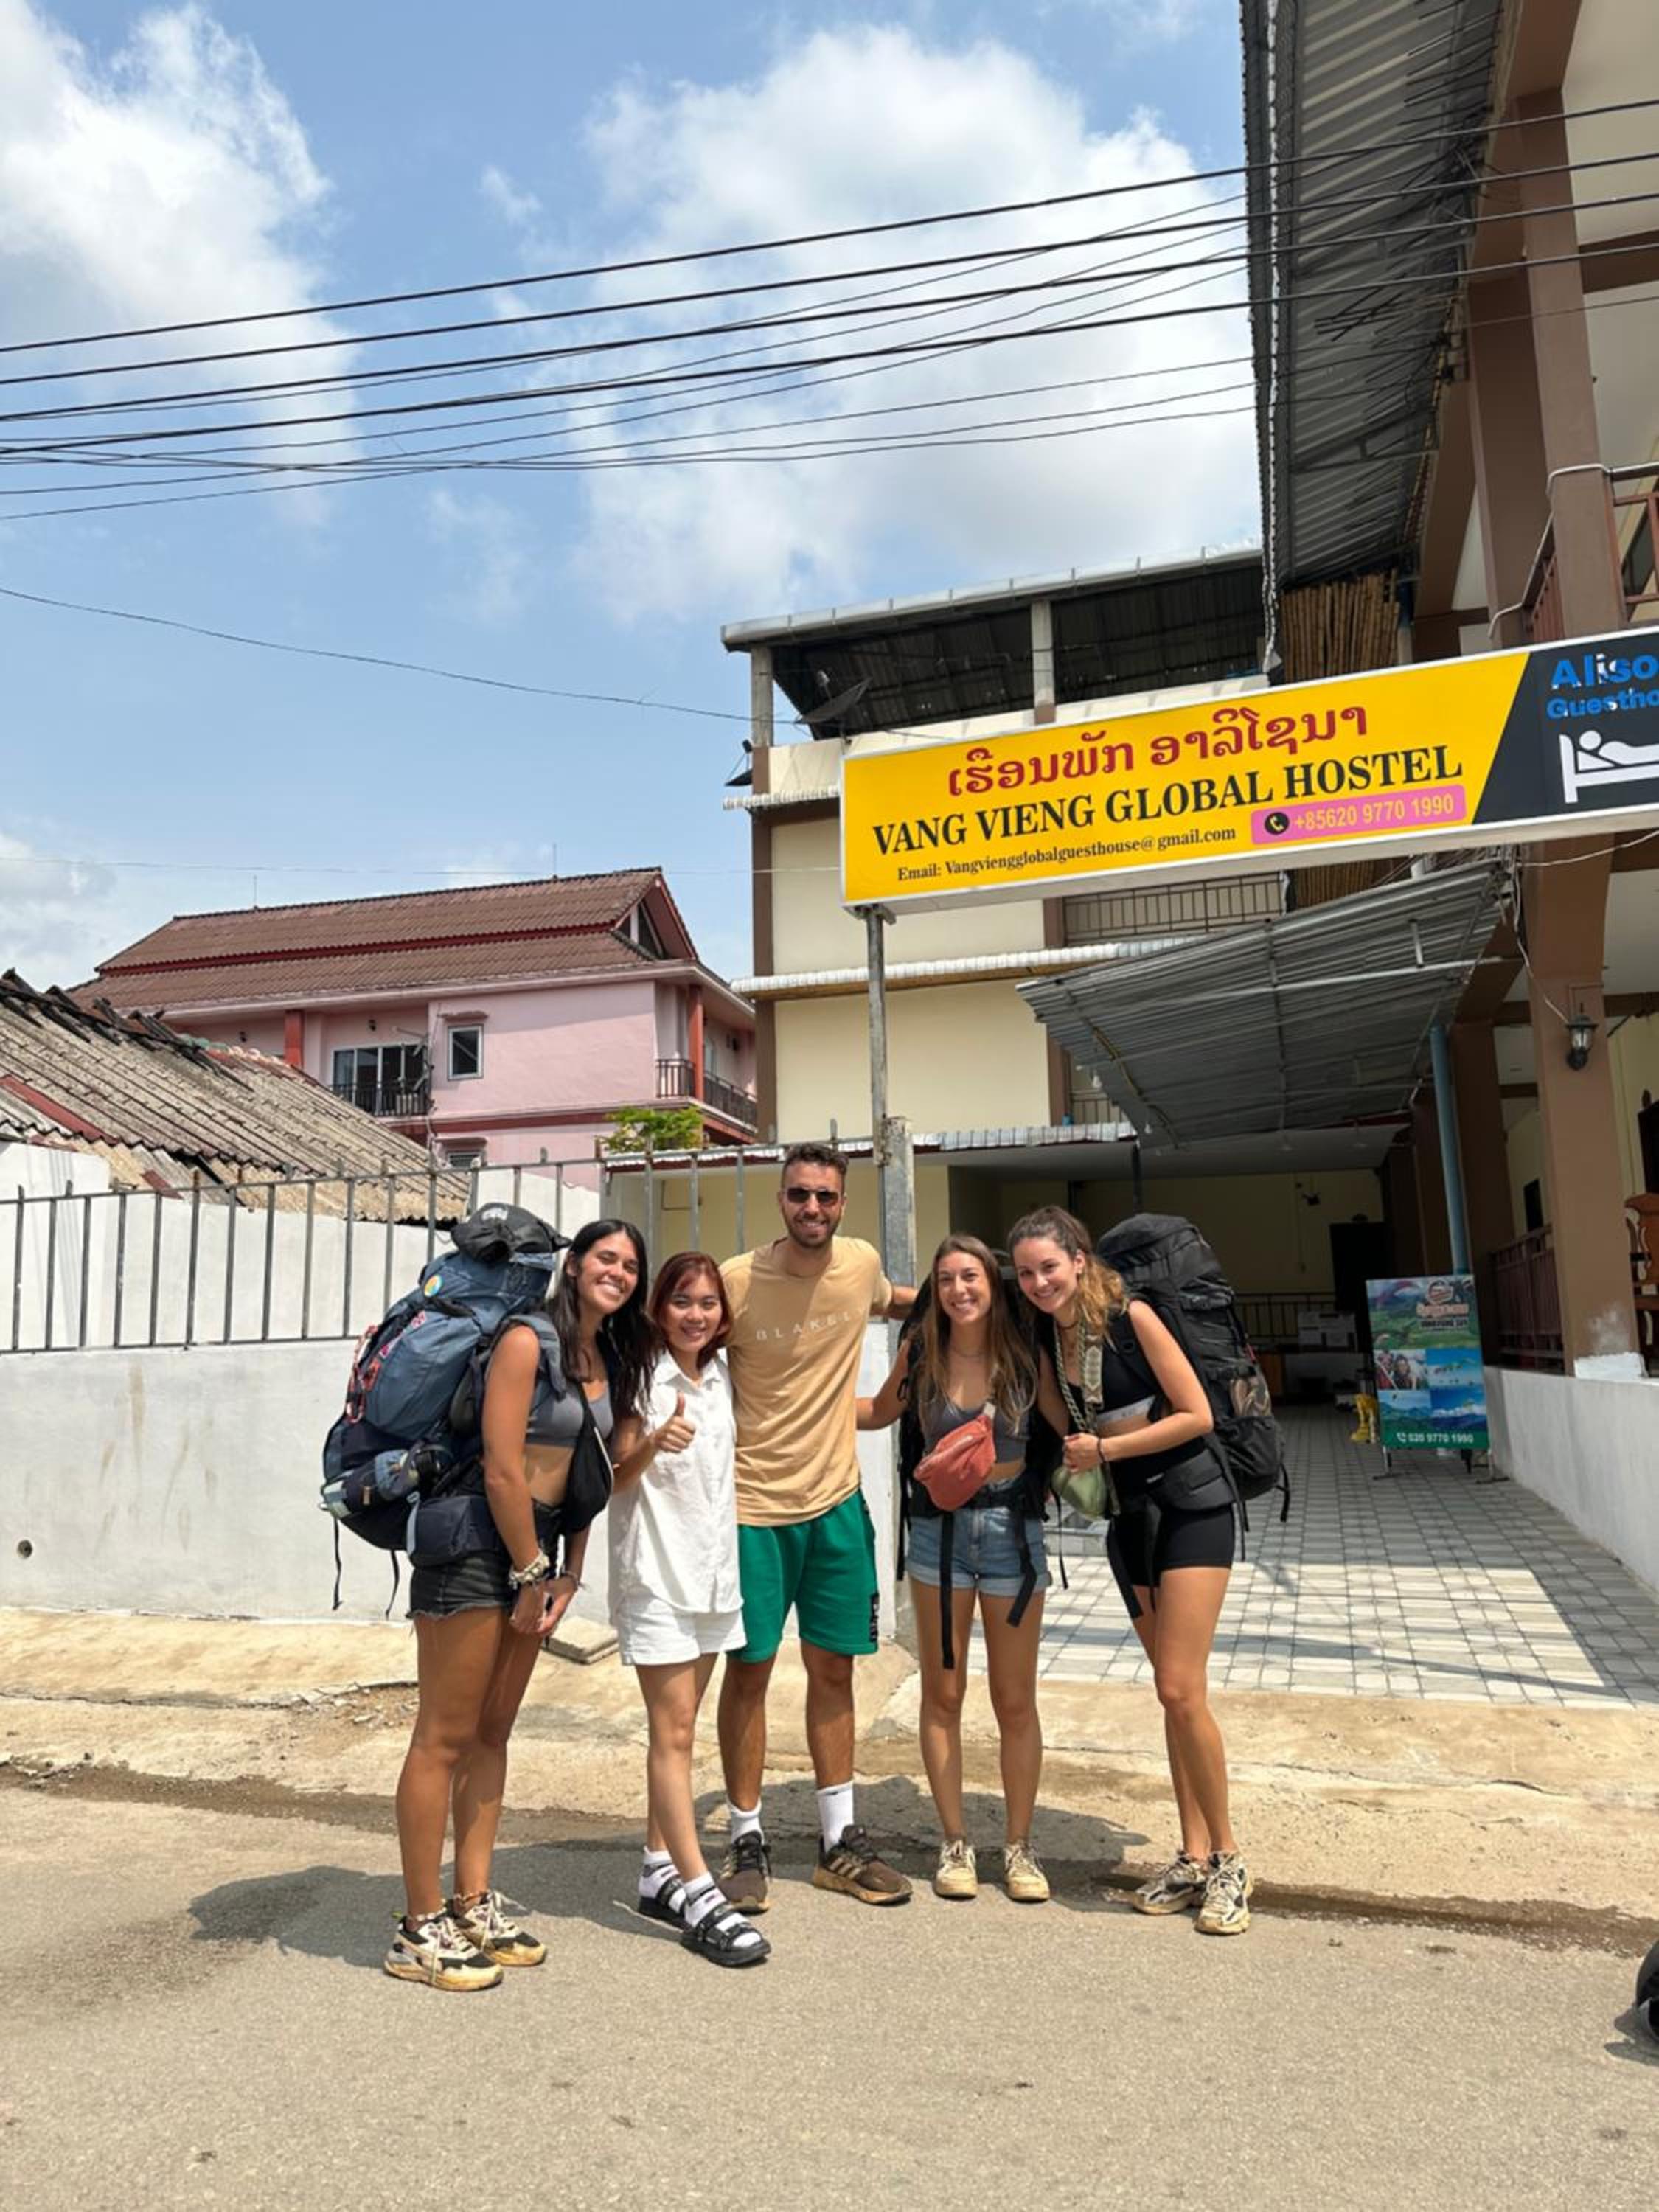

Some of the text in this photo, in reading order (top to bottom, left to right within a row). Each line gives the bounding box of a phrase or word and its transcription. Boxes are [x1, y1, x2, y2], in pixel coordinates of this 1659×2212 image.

[873, 745, 1463, 855] VANG VIENG GLOBAL HOSTEL
[1295, 793, 1453, 831] +85620 9770 1990
[897, 863, 942, 881] Email:
